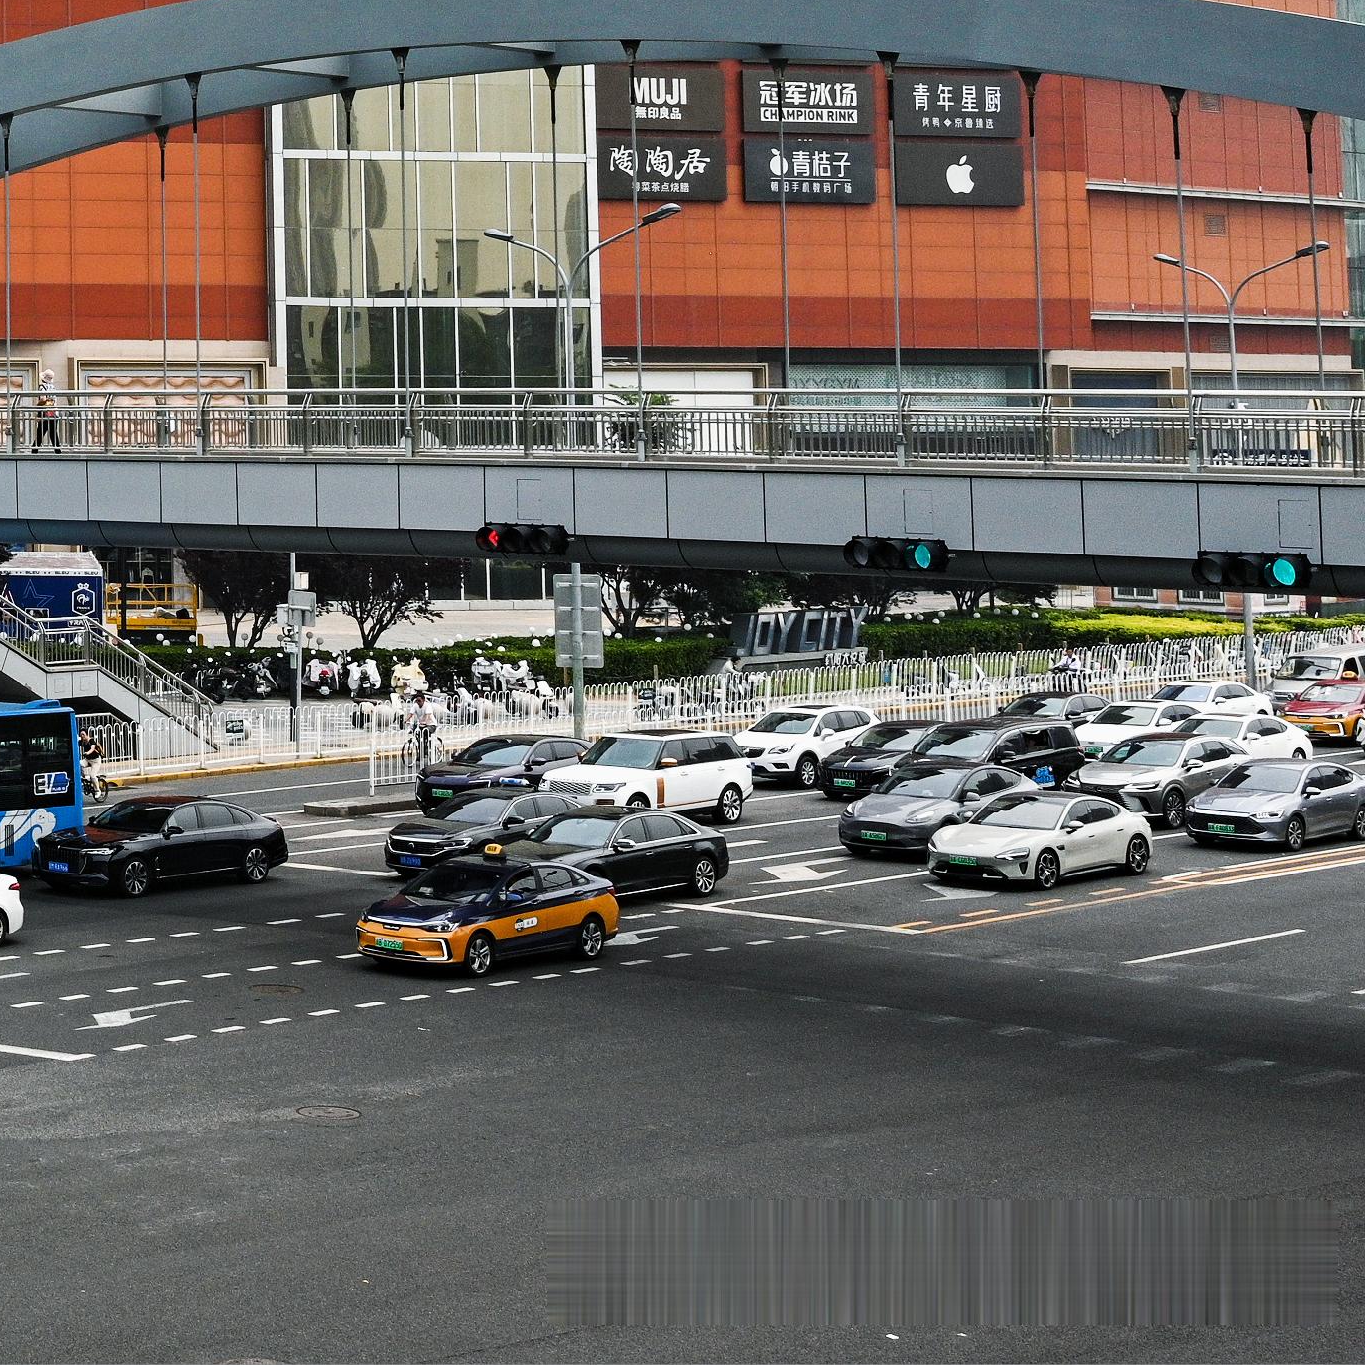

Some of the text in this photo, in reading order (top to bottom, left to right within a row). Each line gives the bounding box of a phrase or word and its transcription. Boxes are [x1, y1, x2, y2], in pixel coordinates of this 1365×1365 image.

[629, 77, 687, 105] MUJI
[759, 80, 858, 107] 冠军冰场
[912, 83, 1001, 113] 青年星厨
[635, 106, 682, 120] 無印良品
[763, 109, 855, 122] CHAMPION RINK
[609, 145, 711, 180] 陶陶居
[791, 150, 851, 178] 青桔子
[737, 605, 869, 657] JOY CITY
